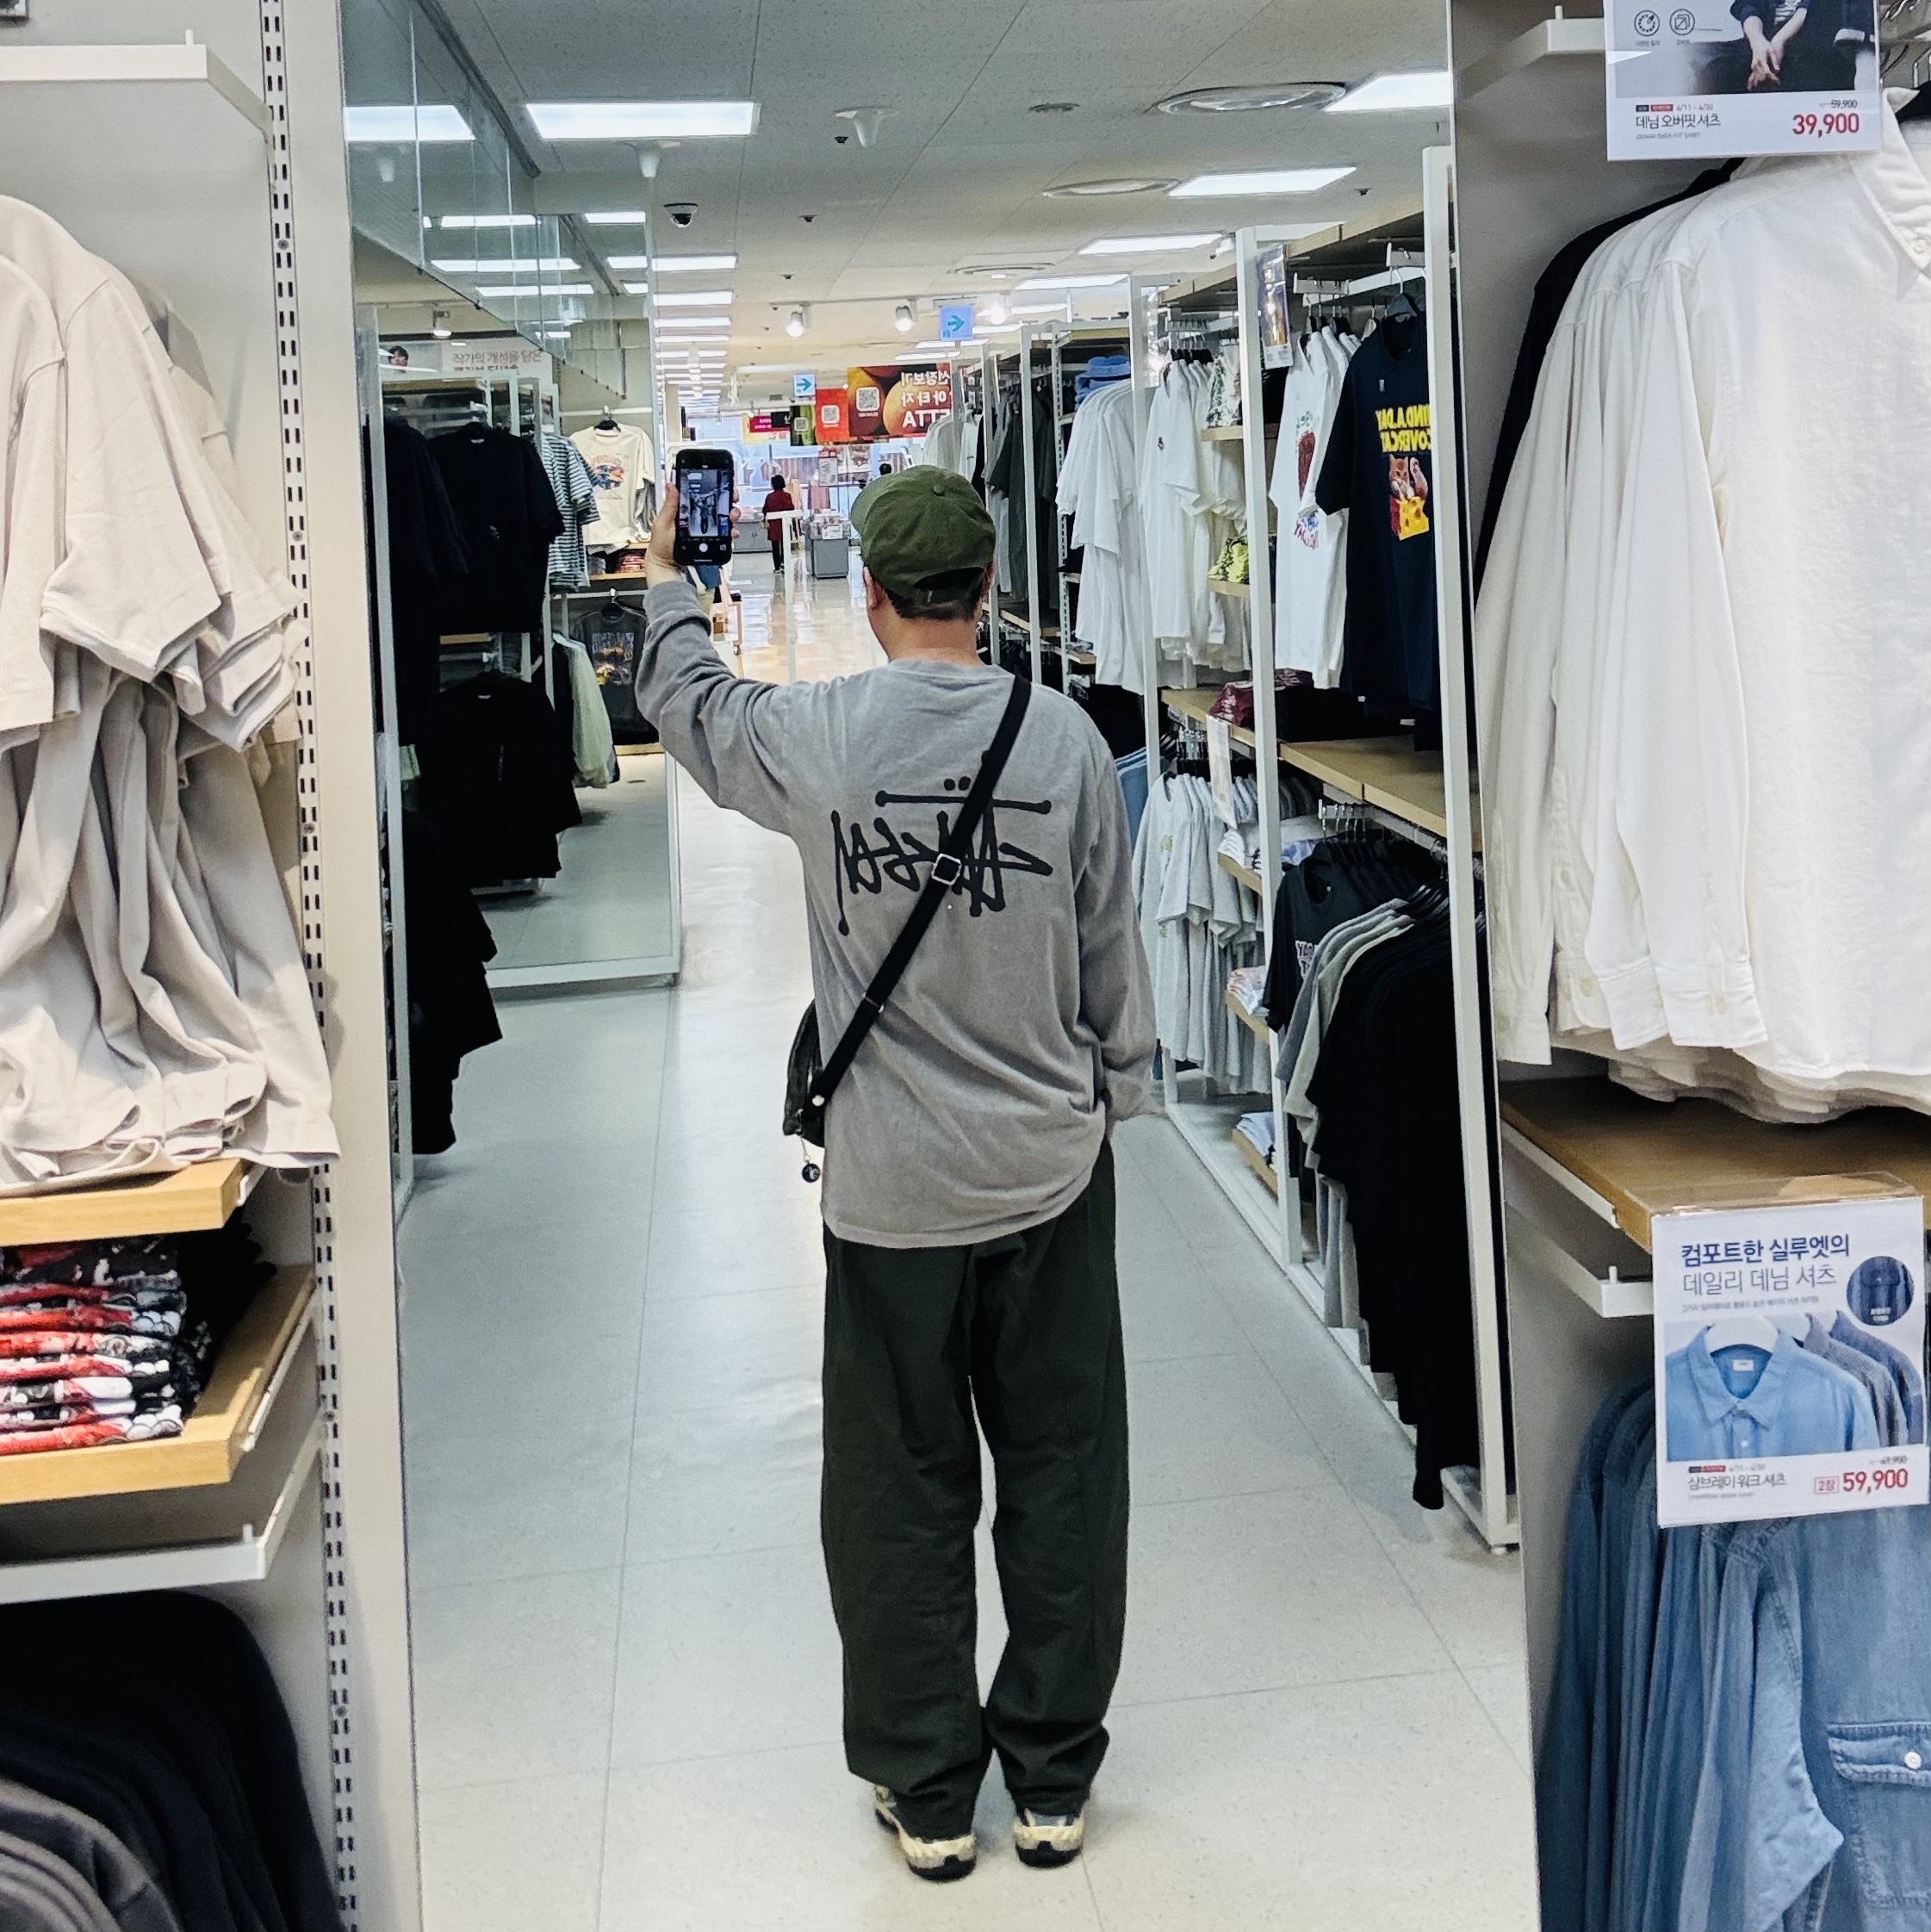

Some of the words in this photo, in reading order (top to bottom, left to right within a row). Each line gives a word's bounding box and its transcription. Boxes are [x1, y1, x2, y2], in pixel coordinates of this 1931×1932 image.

[1636, 115, 1659, 129] 데님
[1661, 114, 1696, 128] 오버핏
[1697, 113, 1721, 127] 셔츠
[1791, 113, 1860, 139] 39,900
[1681, 1240, 1764, 1268] 컴포트한
[1769, 1233, 1850, 1262] 실루엣의
[1683, 1270, 1743, 1295] 데일리
[1750, 1267, 1789, 1291] 데님
[1796, 1264, 1837, 1288] 셔츠
[1737, 1473, 1763, 1488] 워크
[1763, 1472, 1787, 1487] 셔츠
[1842, 1468, 1909, 1494] 59,900
